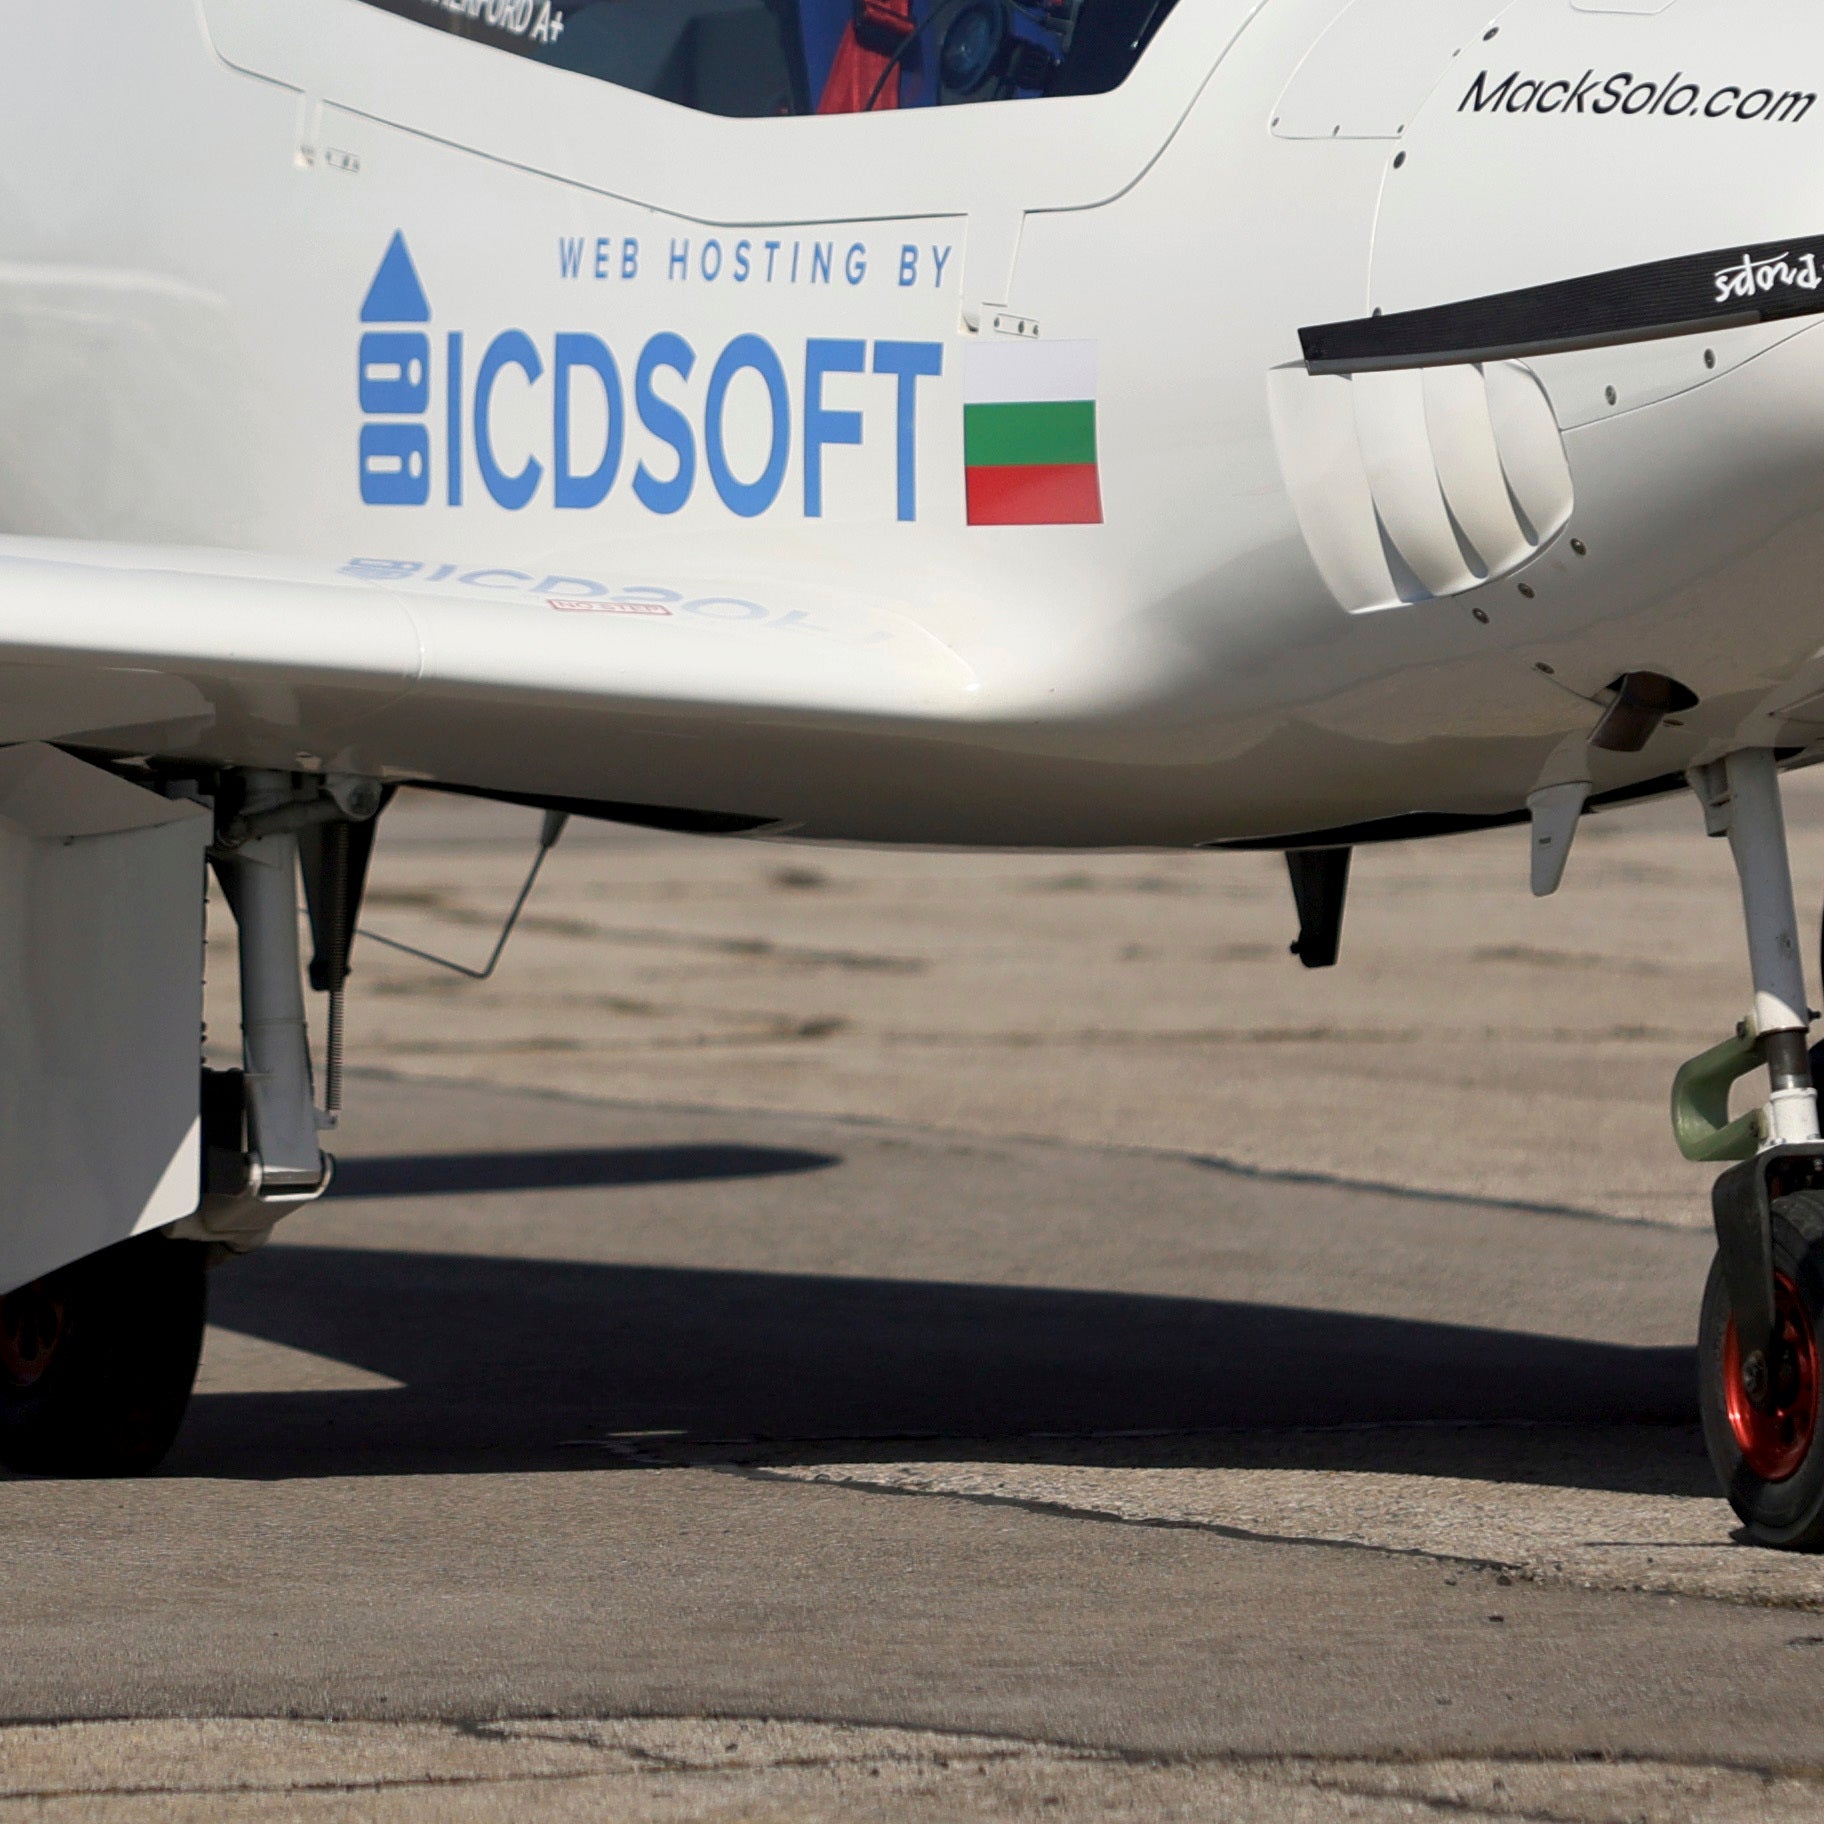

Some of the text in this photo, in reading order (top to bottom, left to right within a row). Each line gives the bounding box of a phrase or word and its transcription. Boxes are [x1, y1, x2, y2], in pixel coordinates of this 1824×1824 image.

[531, 0, 565, 43] A+
[1457, 69, 1819, 123] MackSolo.com
[559, 236, 953, 289] WEB HOSTING BY
[447, 328, 944, 523] ICDSOFT
